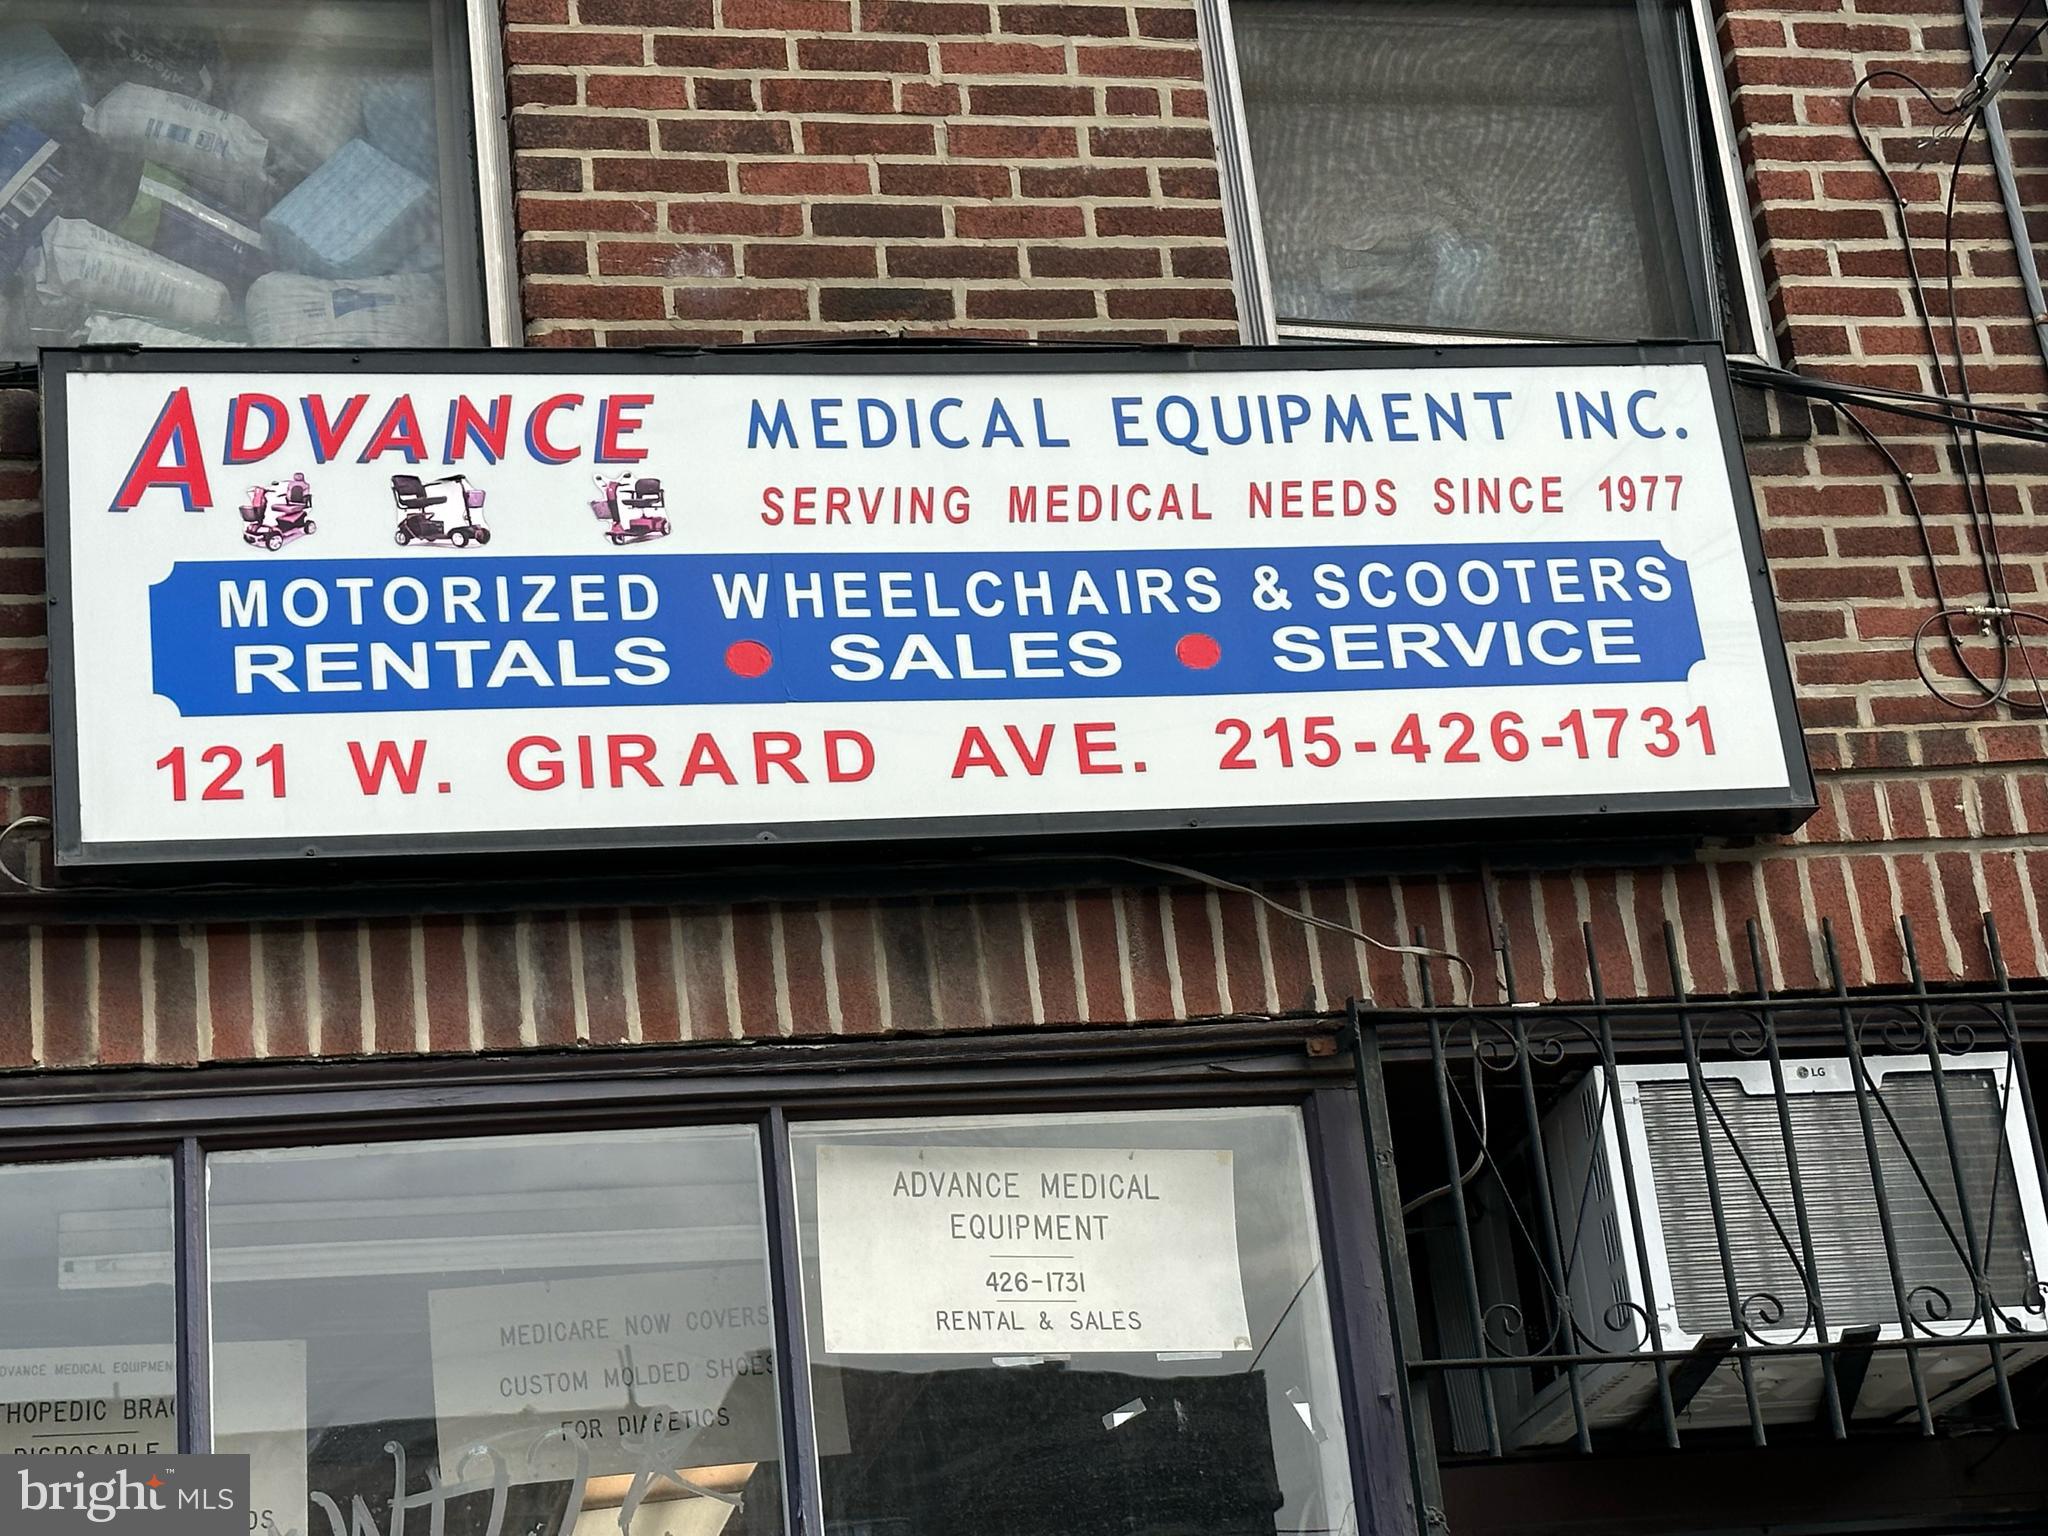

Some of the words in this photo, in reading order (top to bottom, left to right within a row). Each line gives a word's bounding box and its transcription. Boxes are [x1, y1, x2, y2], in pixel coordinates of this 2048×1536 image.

[109, 385, 655, 514] ADVANCE
[747, 397, 1069, 450] MEDICAL
[1113, 391, 1511, 454] EQUIPMENT
[1555, 389, 1689, 439] INC.
[761, 485, 970, 526] SERVING
[1008, 482, 1211, 524] MEDICAL
[1249, 479, 1397, 519] NEEDS
[1434, 475, 1563, 514] SINCE
[1599, 475, 1683, 512] 1977
[219, 572, 660, 629] MOTORIZED
[711, 566, 1223, 621] WHEELCHAIRS
[1252, 564, 1293, 612] &
[1313, 556, 1673, 610] SCOOTERS
[233, 635, 671, 695] RENTALS
[829, 629, 1123, 683] SALES
[1271, 618, 1641, 674] SERVICE
[155, 742, 287, 802] 121
[347, 738, 452, 797] W.
[506, 728, 876, 792] GIRARD
[951, 720, 1148, 779] AVE.
[1214, 704, 1719, 770] 215-426-1731
[1810, 1066, 1826, 1077] LG
[892, 1170, 1021, 1199] ADVANCE
[1040, 1172, 1161, 1201] MEDICAL
[950, 1213, 1109, 1242] EQUIPMENT
[985, 1271, 1086, 1293] 426-1731
[500, 1318, 609, 1346] MEDICARE
[625, 1313, 670, 1336] NOW
[685, 1305, 769, 1331] COVERS
[935, 1310, 1026, 1331] RENTAL
[1038, 1311, 1055, 1331] &
[1069, 1311, 1143, 1331] SALES
[55, 1362, 105, 1376] MEDICAL
[500, 1371, 587, 1397] CUSTOM
[604, 1361, 690, 1388] MOLDED
[706, 1354, 773, 1379] SHOES
[0, 1401, 107, 1424] HOPEDIC
